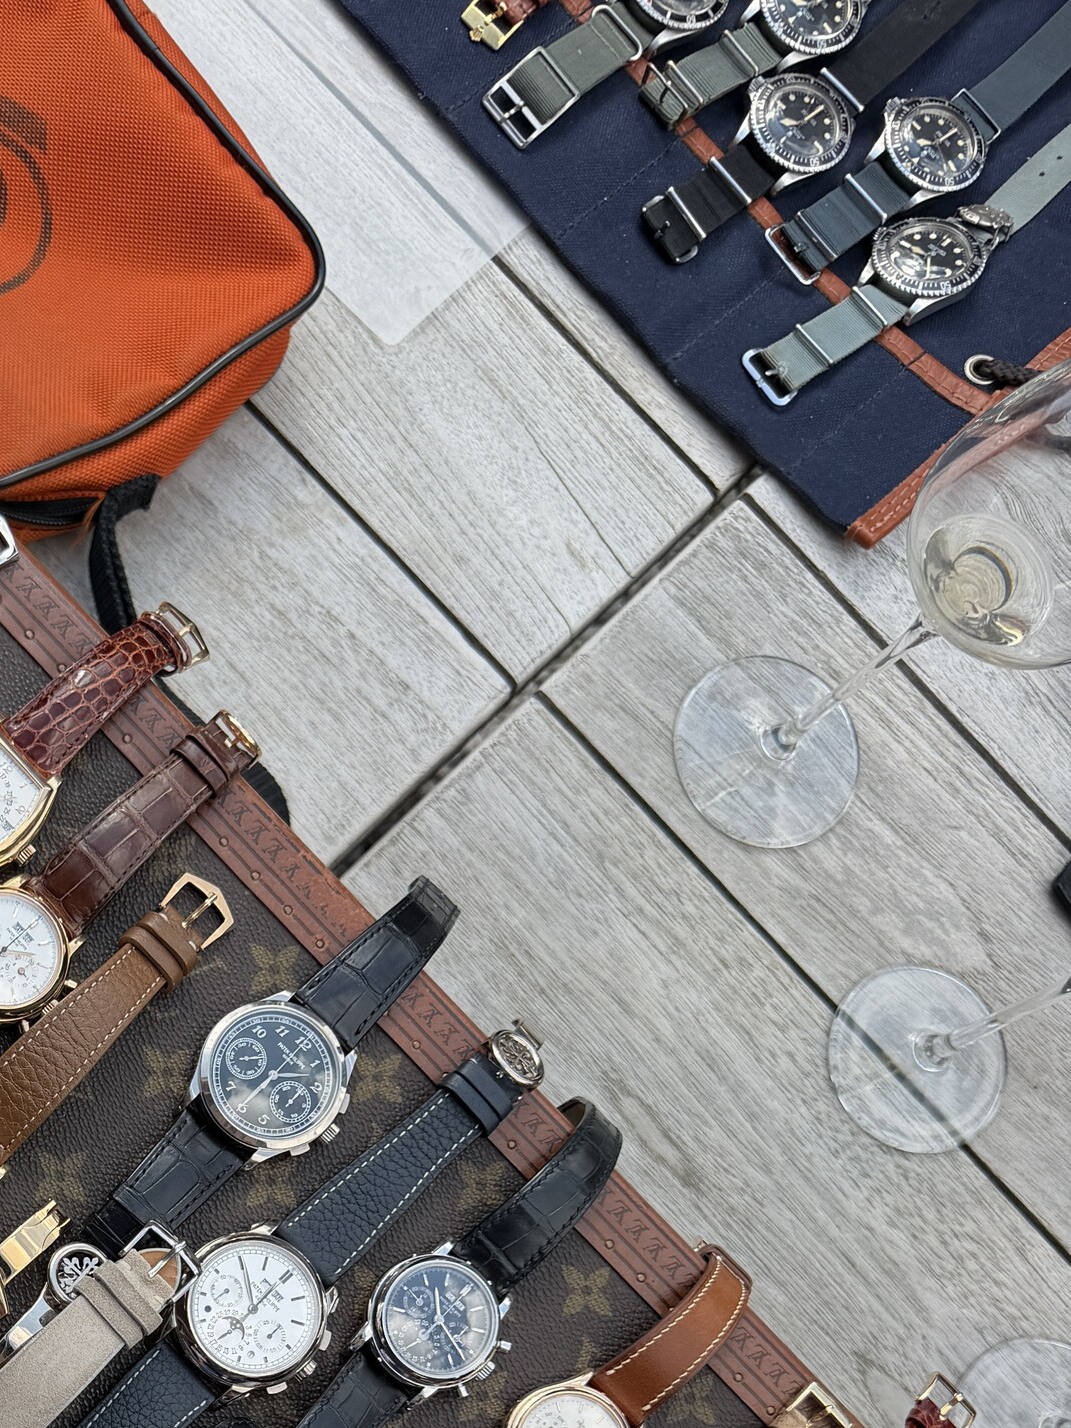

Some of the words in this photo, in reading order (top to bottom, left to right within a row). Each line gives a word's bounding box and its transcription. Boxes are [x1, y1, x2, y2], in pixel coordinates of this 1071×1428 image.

[0, 761, 13, 775] 12
[16, 806, 26, 815] 2
[252, 1026, 267, 1038] 10
[275, 1026, 290, 1037] 11
[276, 1041, 290, 1054] PATEK
[295, 1036, 312, 1052] 12
[310, 1060, 320, 1068] 1
[226, 1081, 237, 1092] 7
[310, 1082, 322, 1094] 2
[258, 1115, 270, 1124] 5
